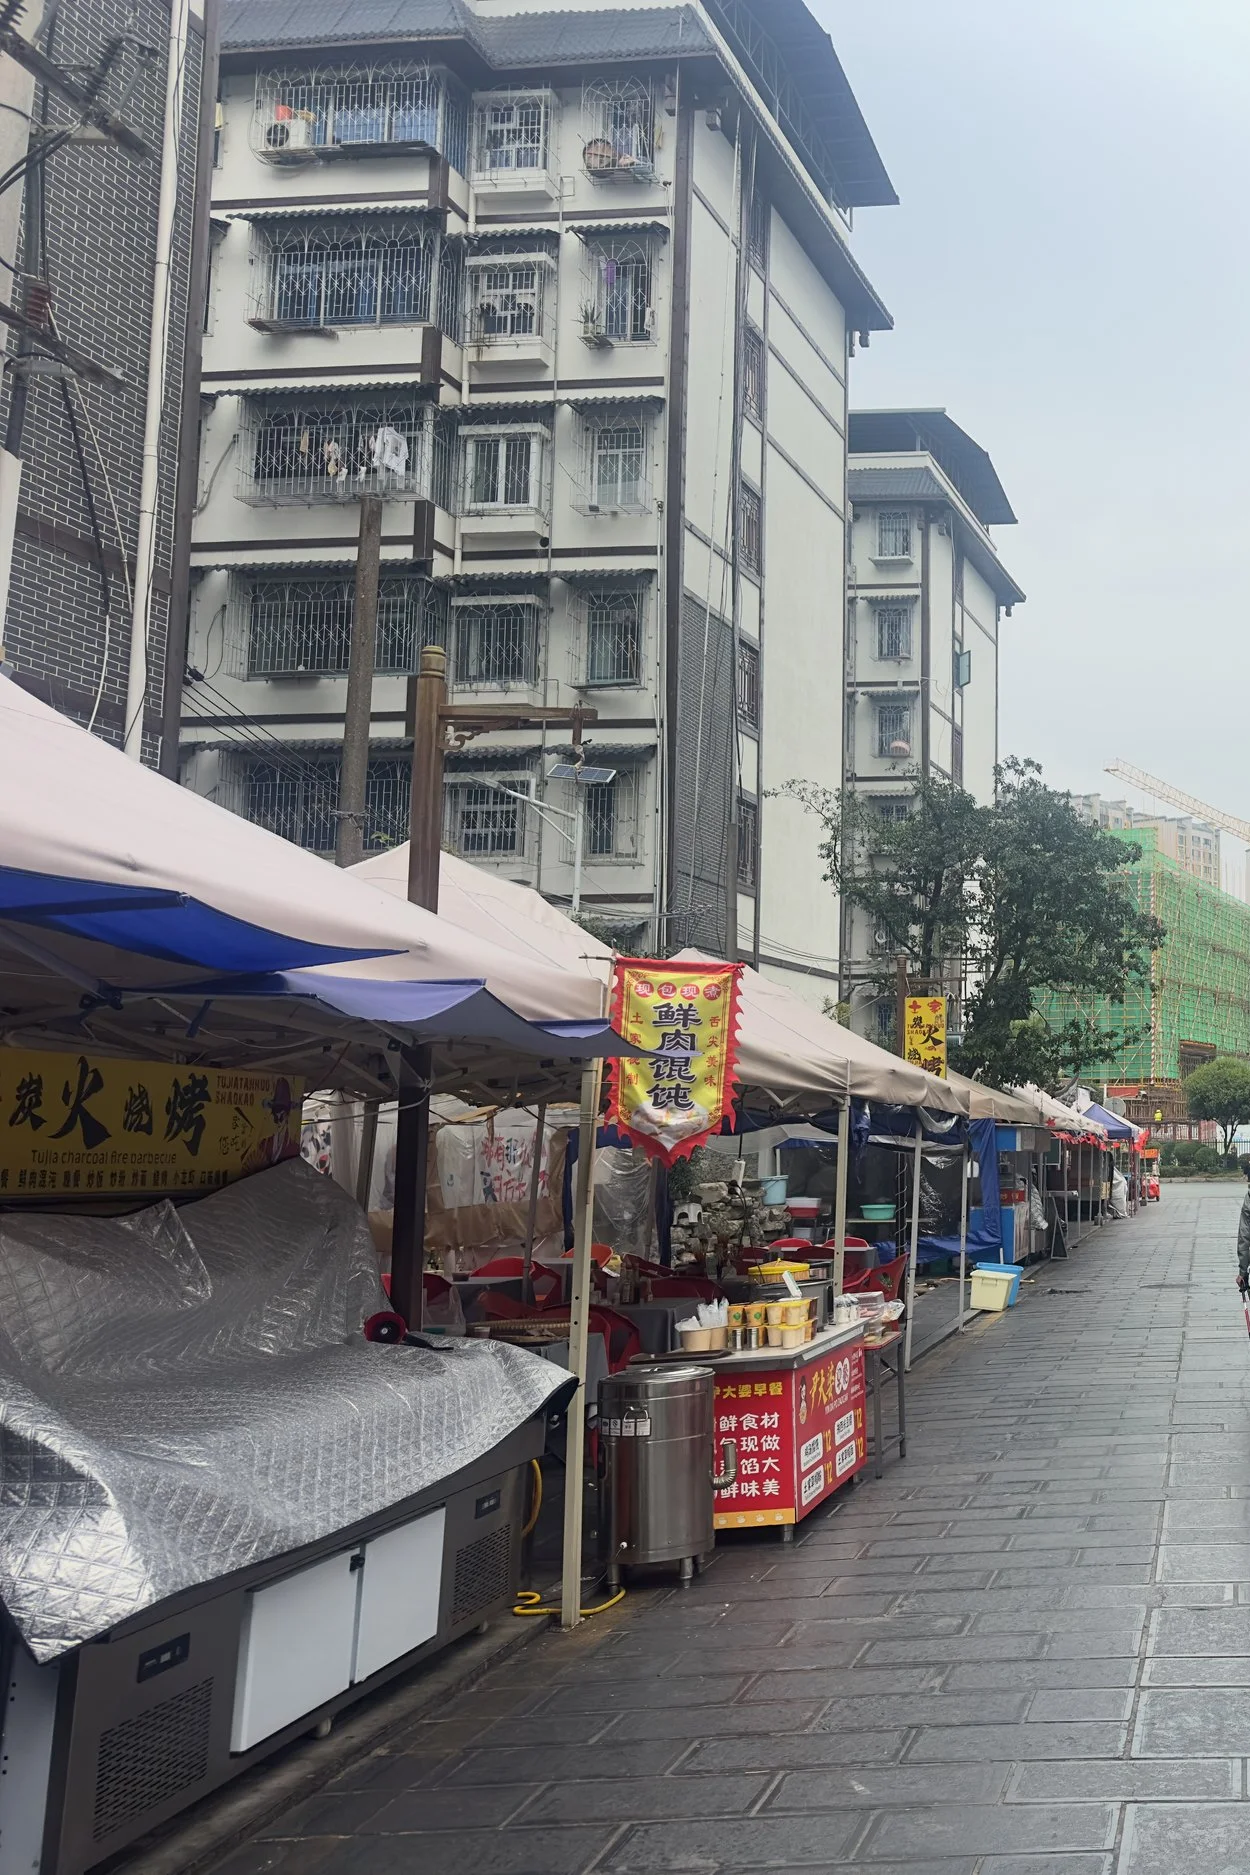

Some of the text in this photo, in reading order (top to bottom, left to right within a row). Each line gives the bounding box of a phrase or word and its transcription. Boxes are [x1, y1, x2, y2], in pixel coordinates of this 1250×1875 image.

[635, 982, 722, 1000] 现包现煮
[646, 1002, 703, 1110] 鲜肉馄饨
[704, 1016, 722, 1087] 舌尖美味
[31, 1149, 177, 1166] Tujia charcoal fire barbecue
[714, 1411, 781, 1432] 鲜食材
